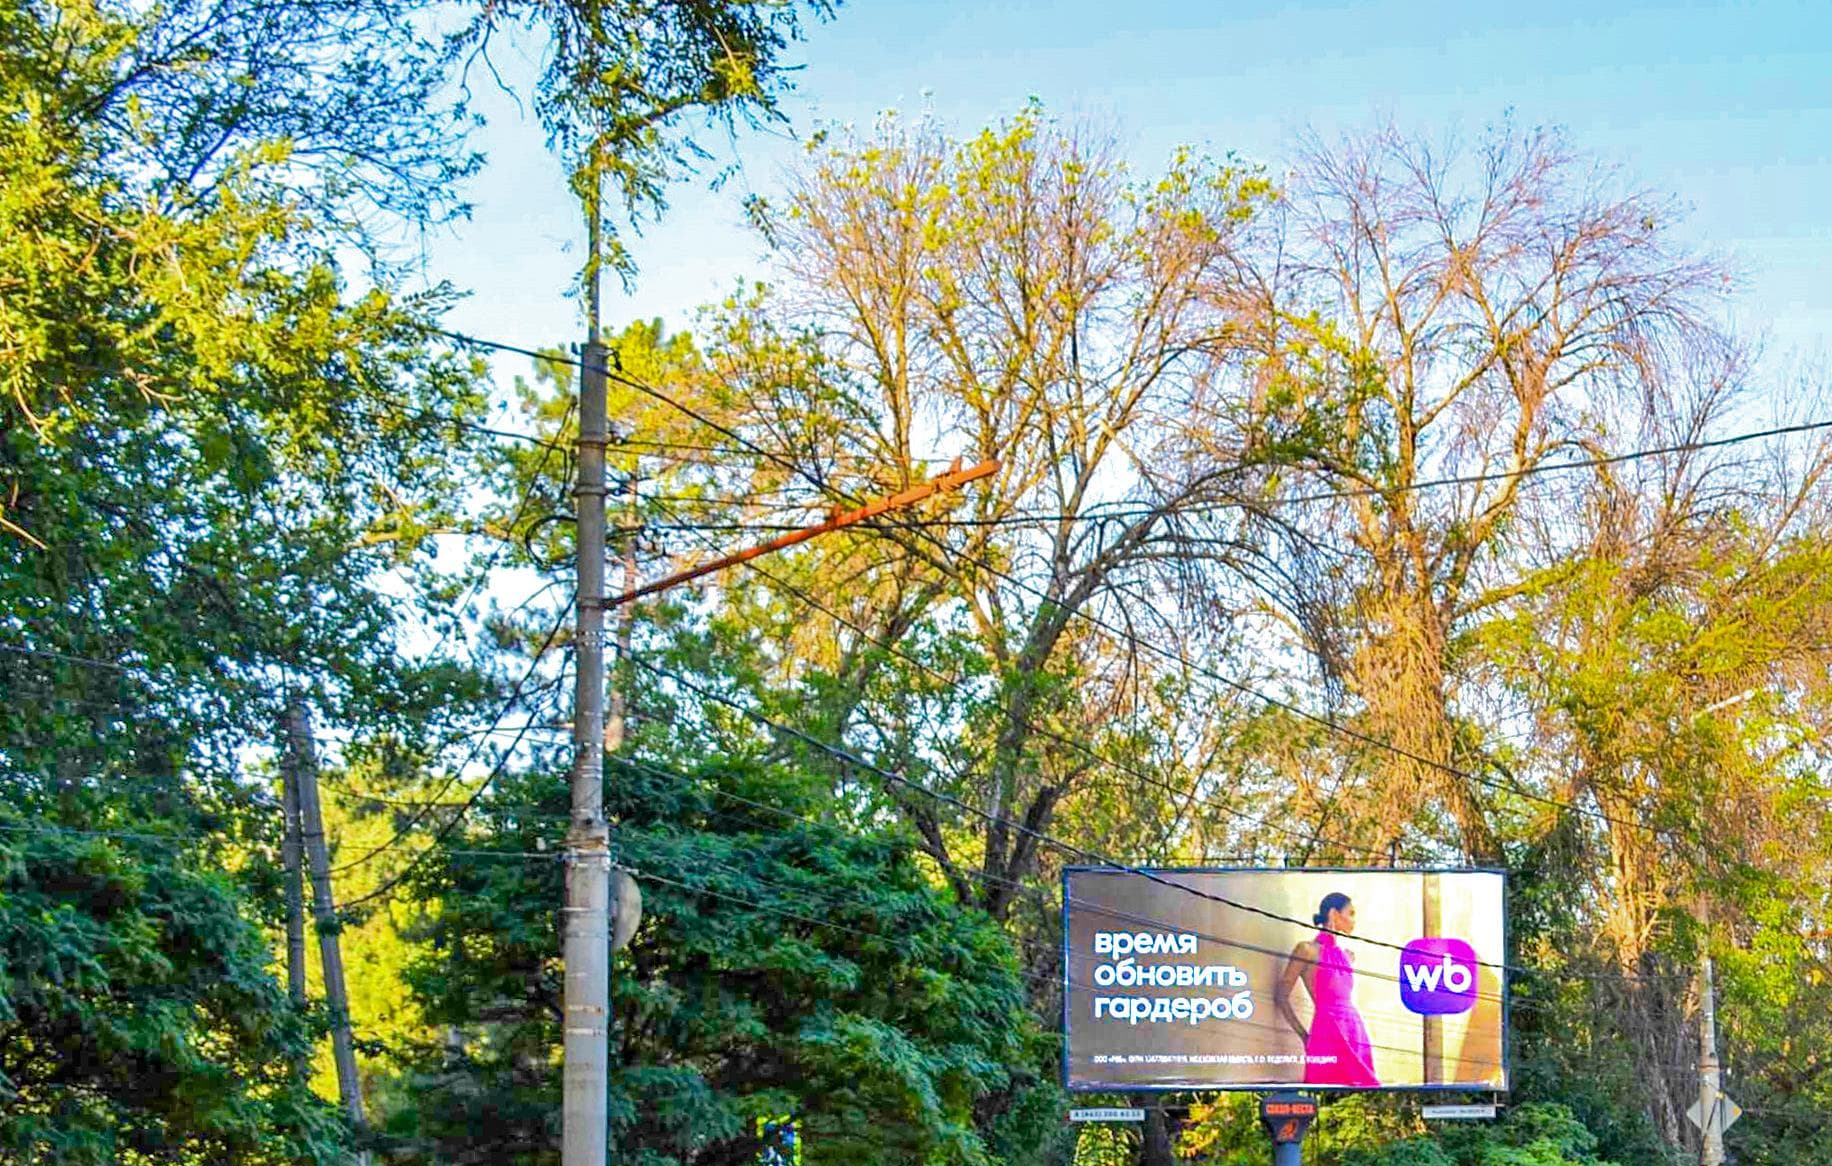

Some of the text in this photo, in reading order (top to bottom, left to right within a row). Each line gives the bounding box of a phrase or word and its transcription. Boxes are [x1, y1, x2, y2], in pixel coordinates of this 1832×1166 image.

[1095, 932, 1198, 960] время
[1094, 957, 1248, 986] обновить
[1403, 952, 1473, 993] wb
[1095, 991, 1254, 1025] гардероб
